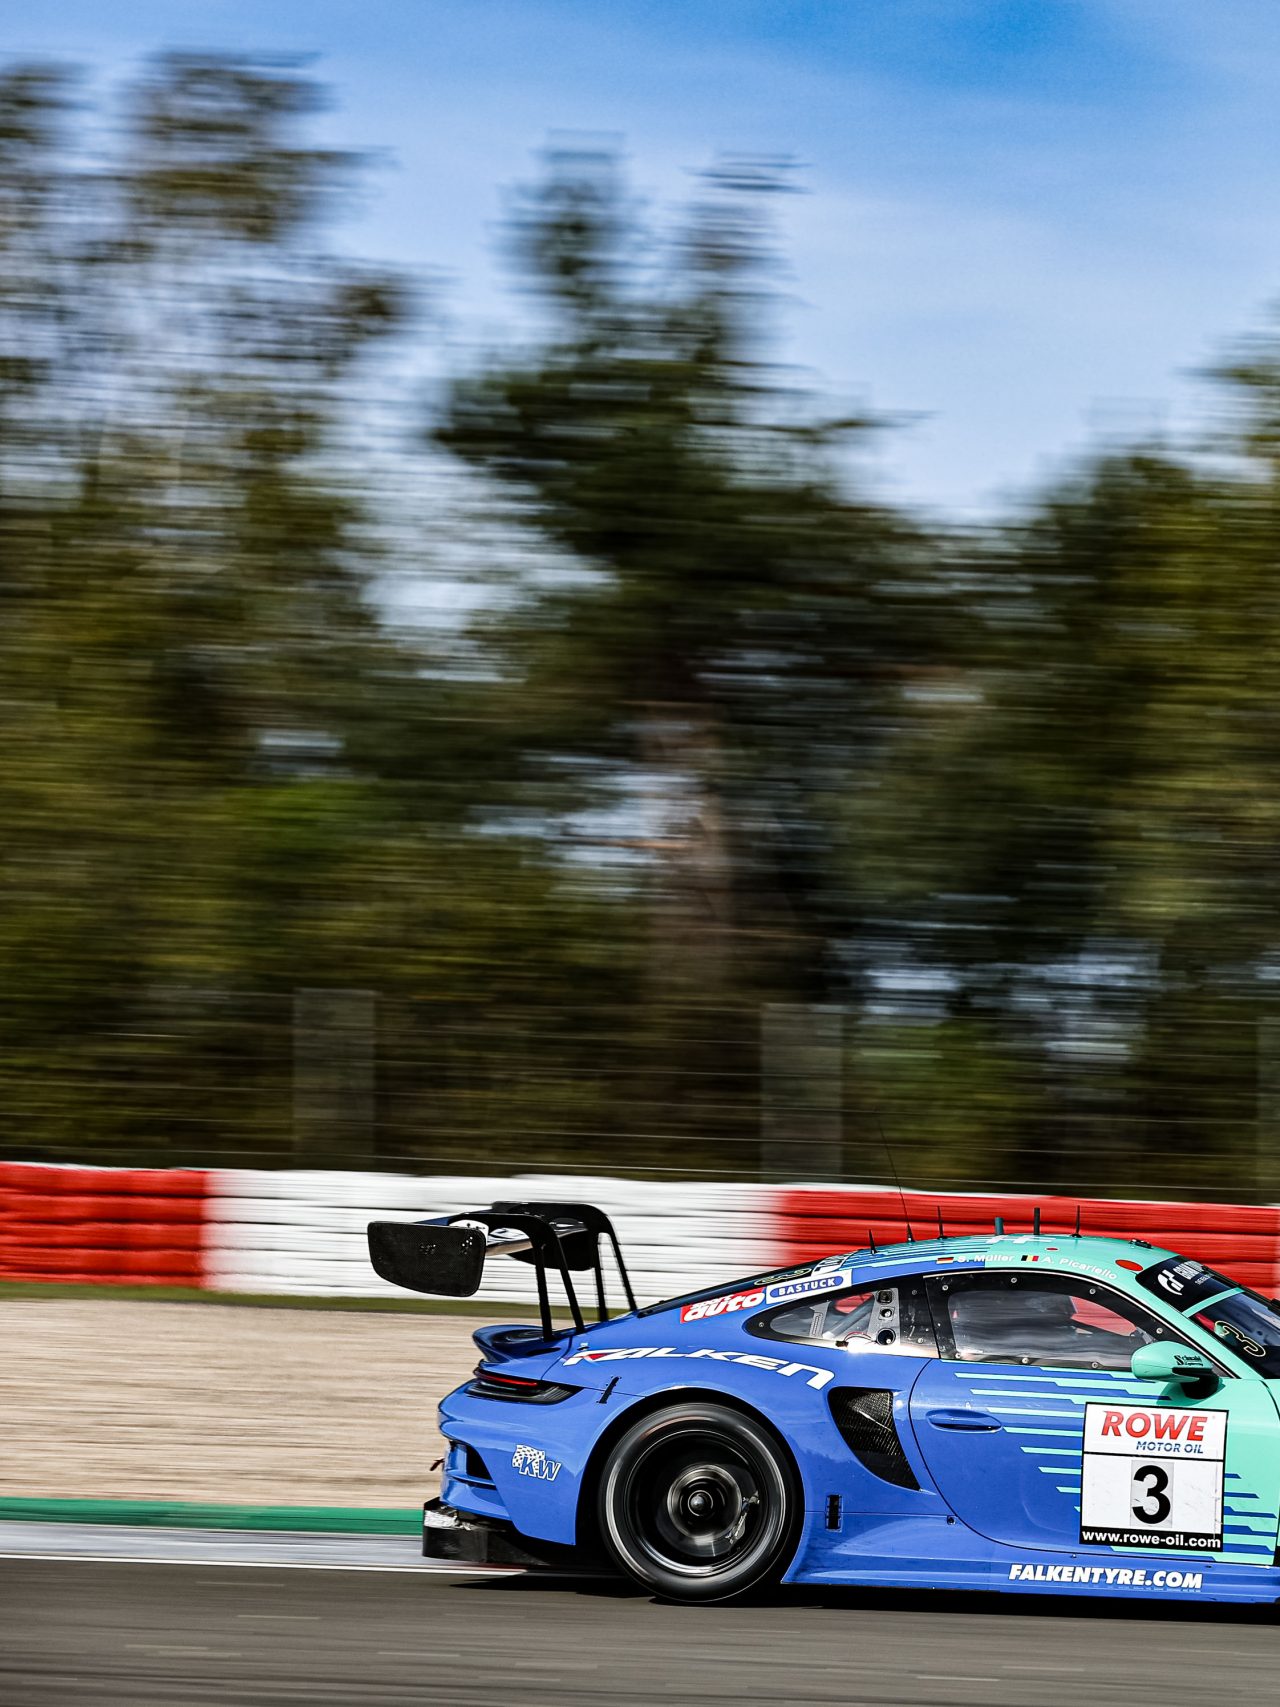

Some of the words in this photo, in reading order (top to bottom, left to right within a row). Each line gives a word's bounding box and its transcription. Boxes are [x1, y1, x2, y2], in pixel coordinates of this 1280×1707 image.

[974, 1254, 1014, 1263] Müller
[1060, 1257, 1118, 1281] Picariello
[778, 1277, 837, 1297] BASTUCK
[683, 1292, 766, 1322] auto
[561, 1346, 836, 1391] FALKEN
[1101, 1410, 1208, 1442] ROWE
[1136, 1441, 1181, 1454] MOTOR
[1184, 1443, 1204, 1455] OIL
[518, 1452, 561, 1482] KW
[1132, 1464, 1171, 1525] 3
[1082, 1530, 1222, 1549] www.rowe-oil.com
[1008, 1564, 1203, 1589] FALKENTYRE.COM
